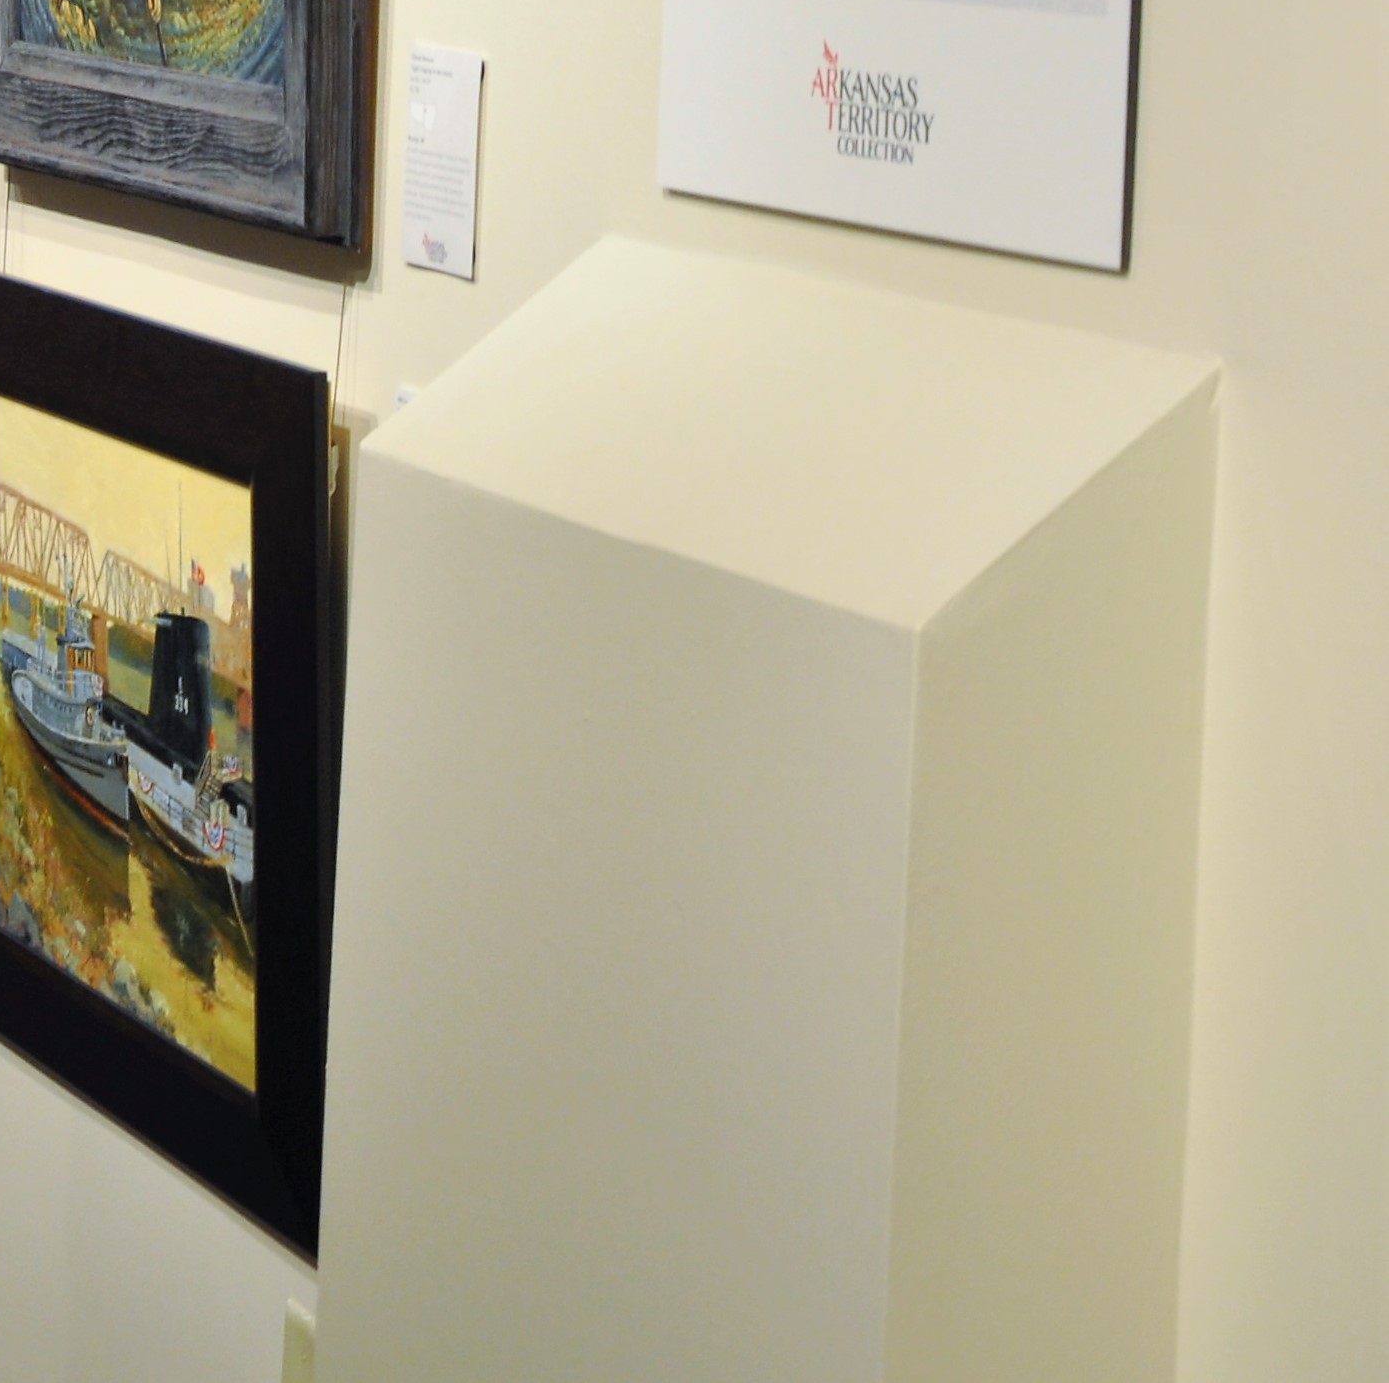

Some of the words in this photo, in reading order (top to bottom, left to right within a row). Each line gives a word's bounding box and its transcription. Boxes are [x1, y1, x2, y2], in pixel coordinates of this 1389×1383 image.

[811, 67, 918, 109] ARKANSAS
[826, 100, 934, 144] TERRITORY
[837, 135, 914, 165] COLLECTION
